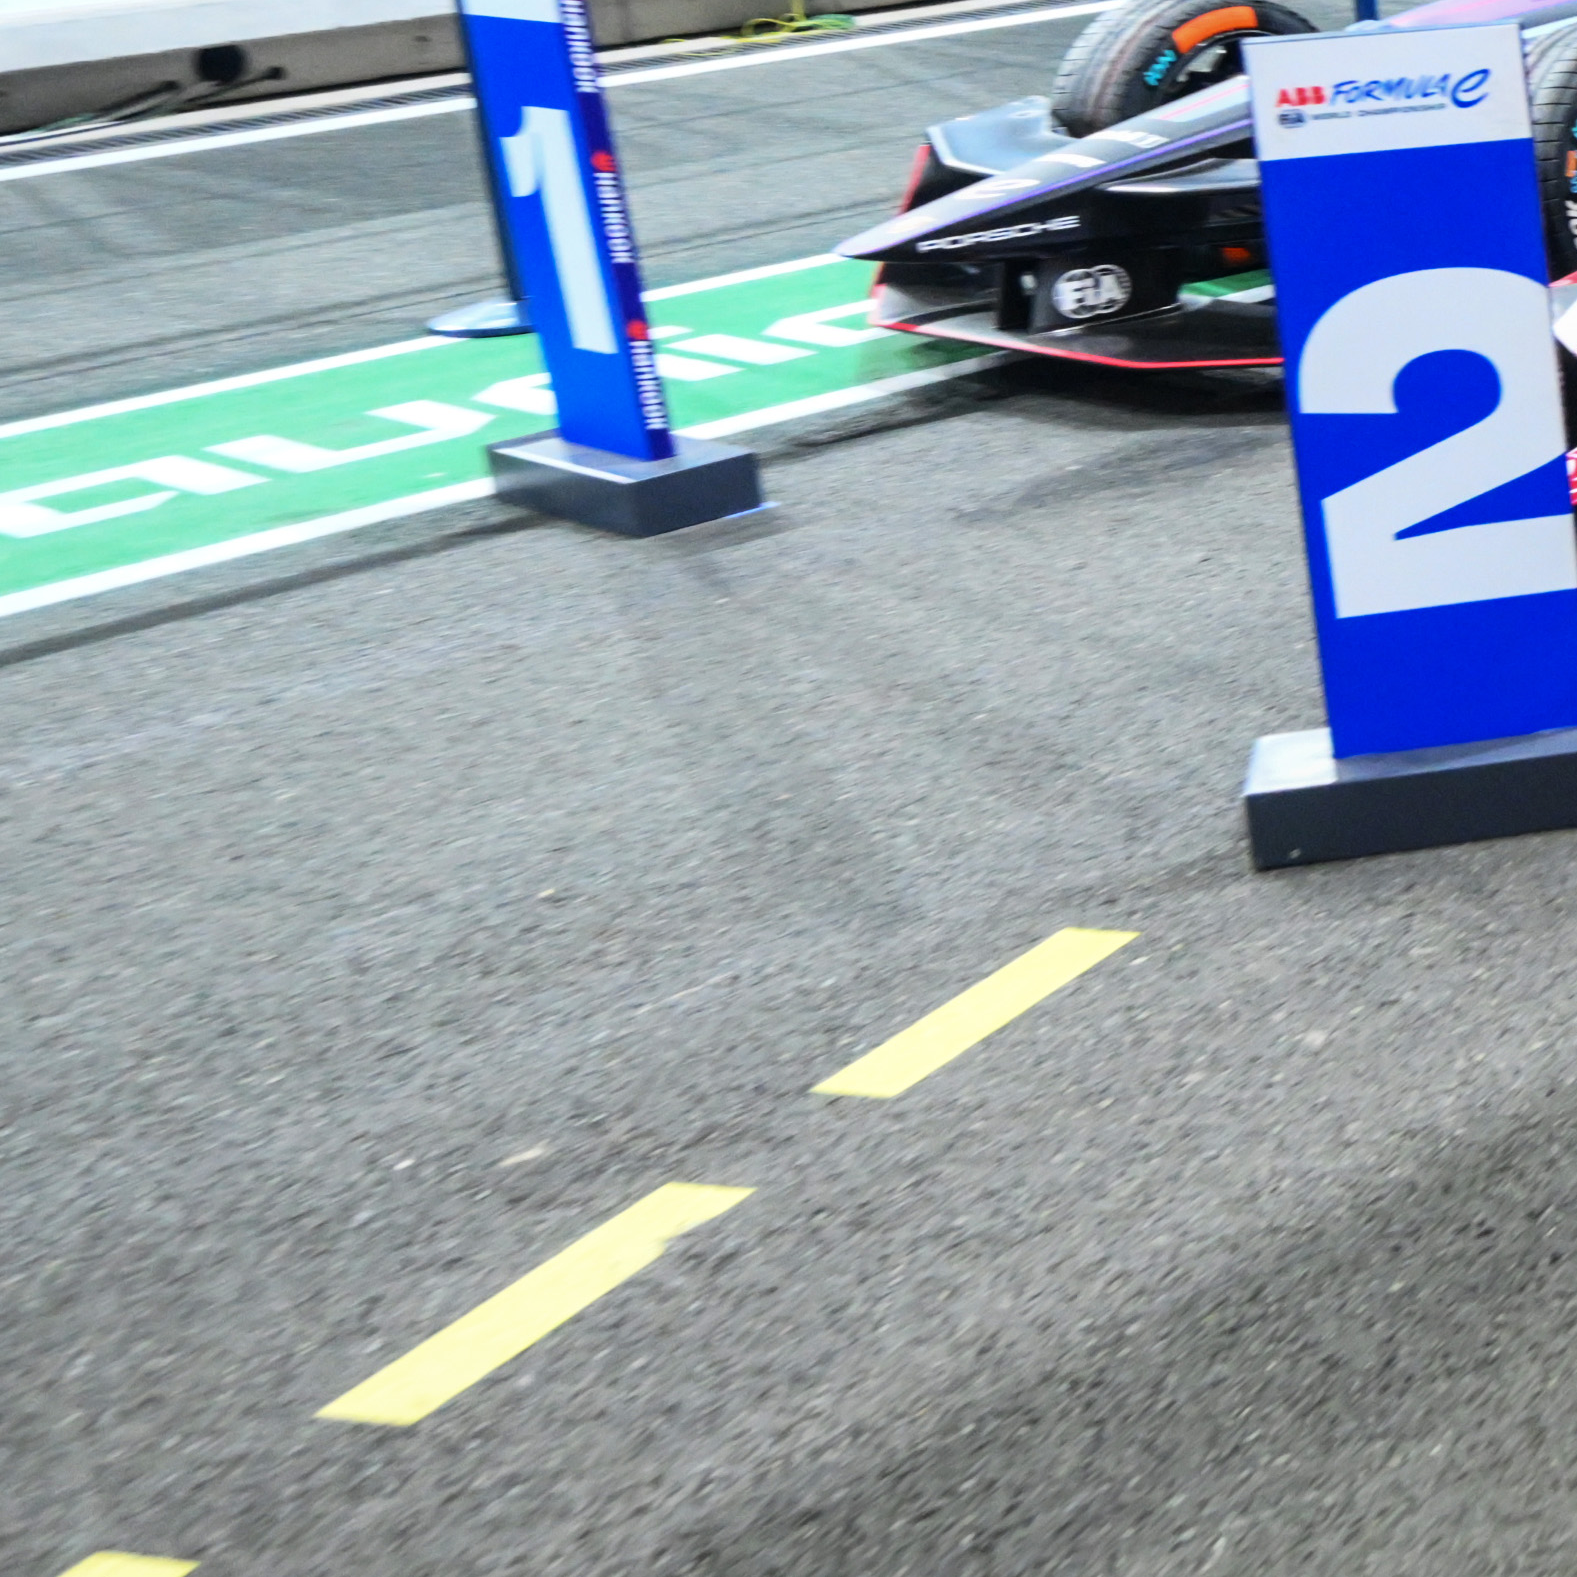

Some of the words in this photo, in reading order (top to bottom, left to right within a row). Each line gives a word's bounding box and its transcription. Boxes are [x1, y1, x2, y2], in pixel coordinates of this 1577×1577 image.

[1276, 86, 1326, 107] ABB
[1329, 73, 1450, 106] FORMULA
[499, 105, 619, 355] 1
[916, 214, 1082, 254] PORSCHE
